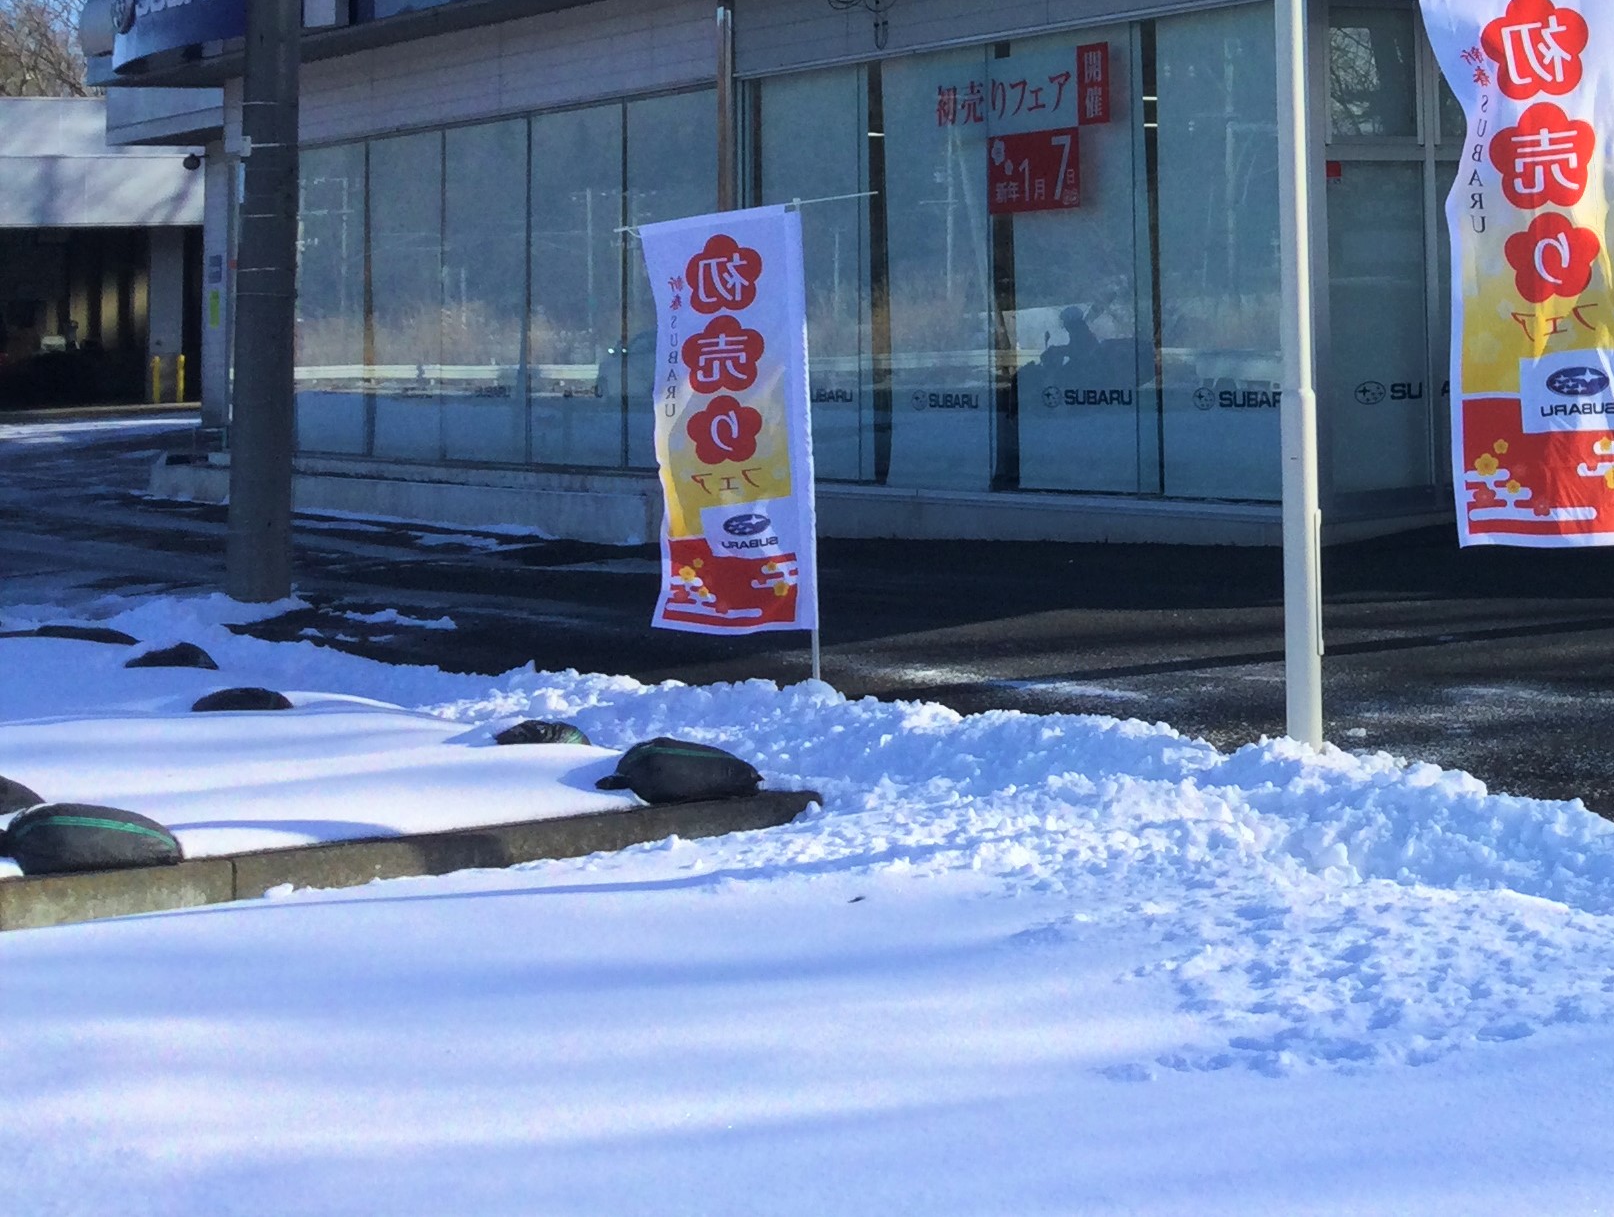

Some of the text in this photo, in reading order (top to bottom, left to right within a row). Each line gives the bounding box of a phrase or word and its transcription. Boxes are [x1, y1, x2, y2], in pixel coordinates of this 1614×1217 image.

[936, 71, 1072, 127] 初売りフェア
[810, 388, 853, 403] UBARU
[928, 392, 979, 409] SUBARU
[1064, 387, 1133, 406] SUBARU
[1219, 390, 1282, 409] SUBAR
